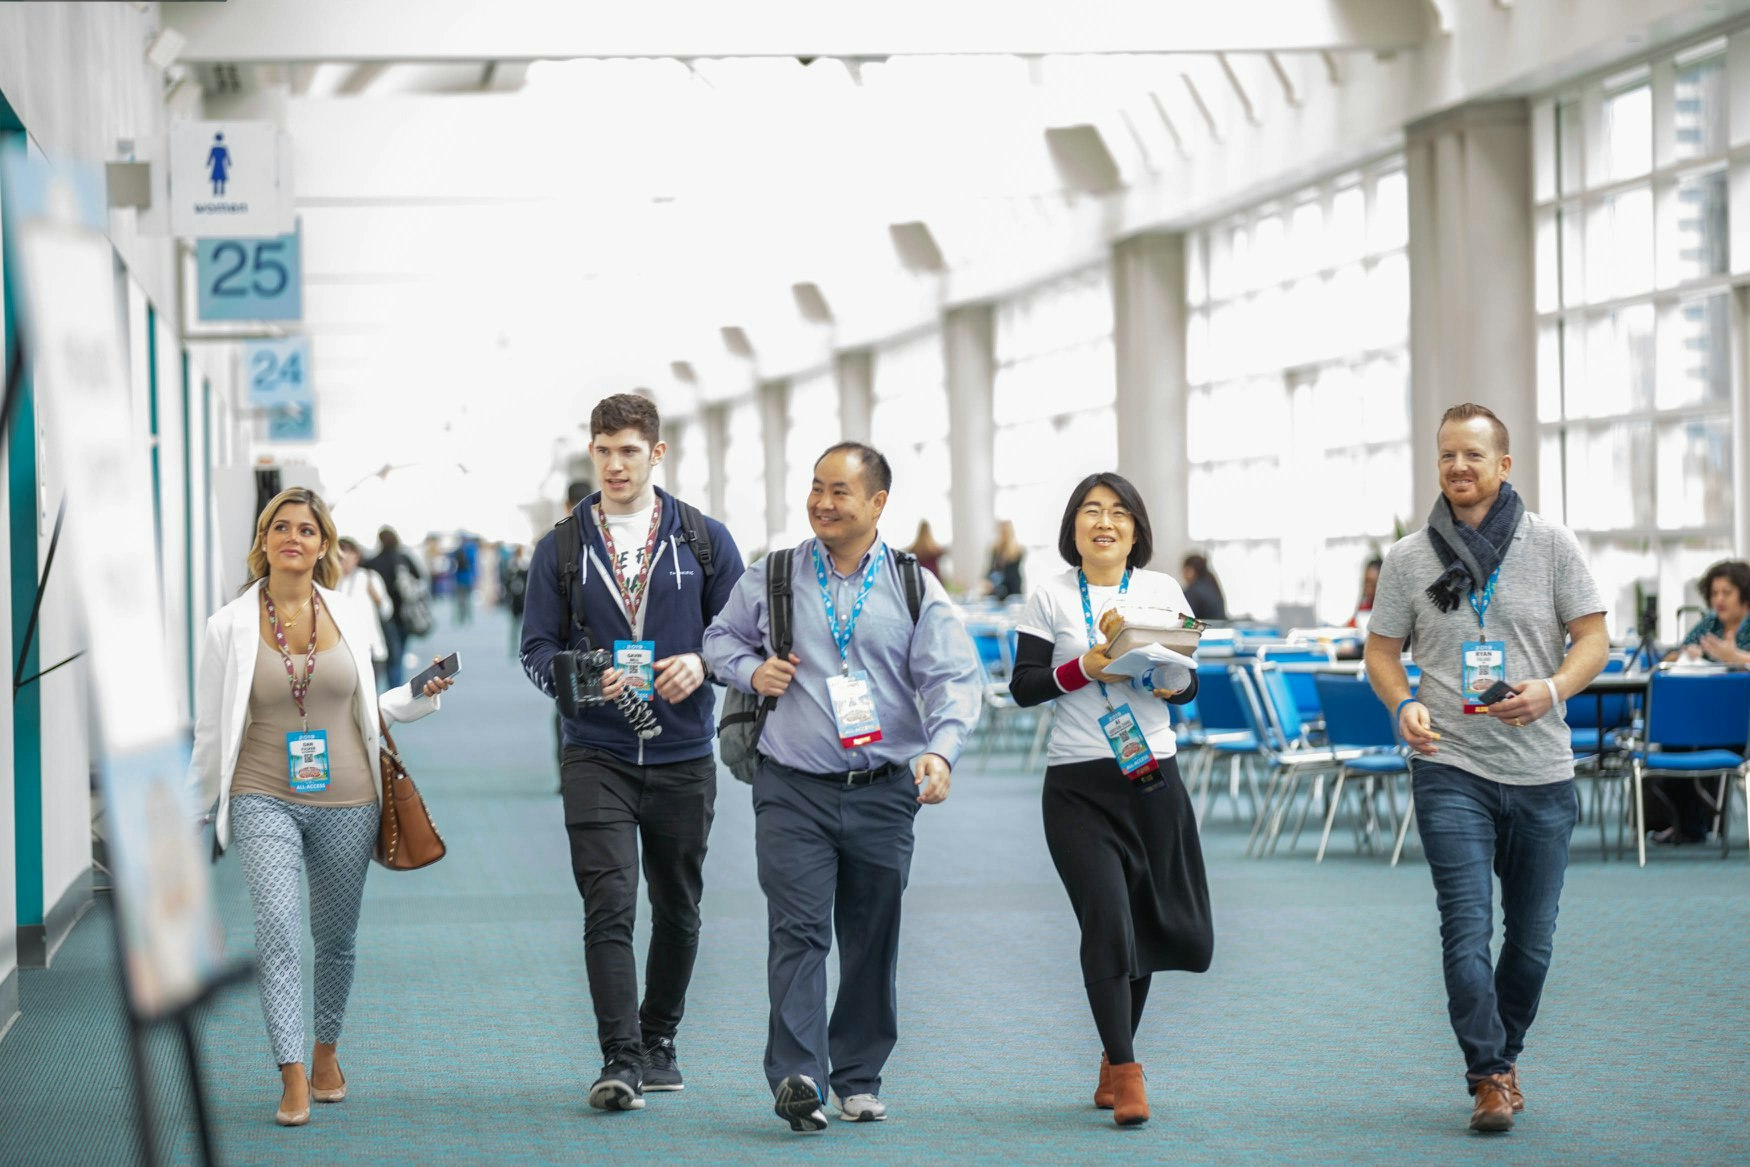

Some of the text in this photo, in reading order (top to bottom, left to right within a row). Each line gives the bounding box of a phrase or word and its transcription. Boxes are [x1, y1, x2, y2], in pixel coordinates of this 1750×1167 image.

[194, 202, 248, 214] women
[211, 241, 288, 299] 25
[251, 351, 303, 391] 24
